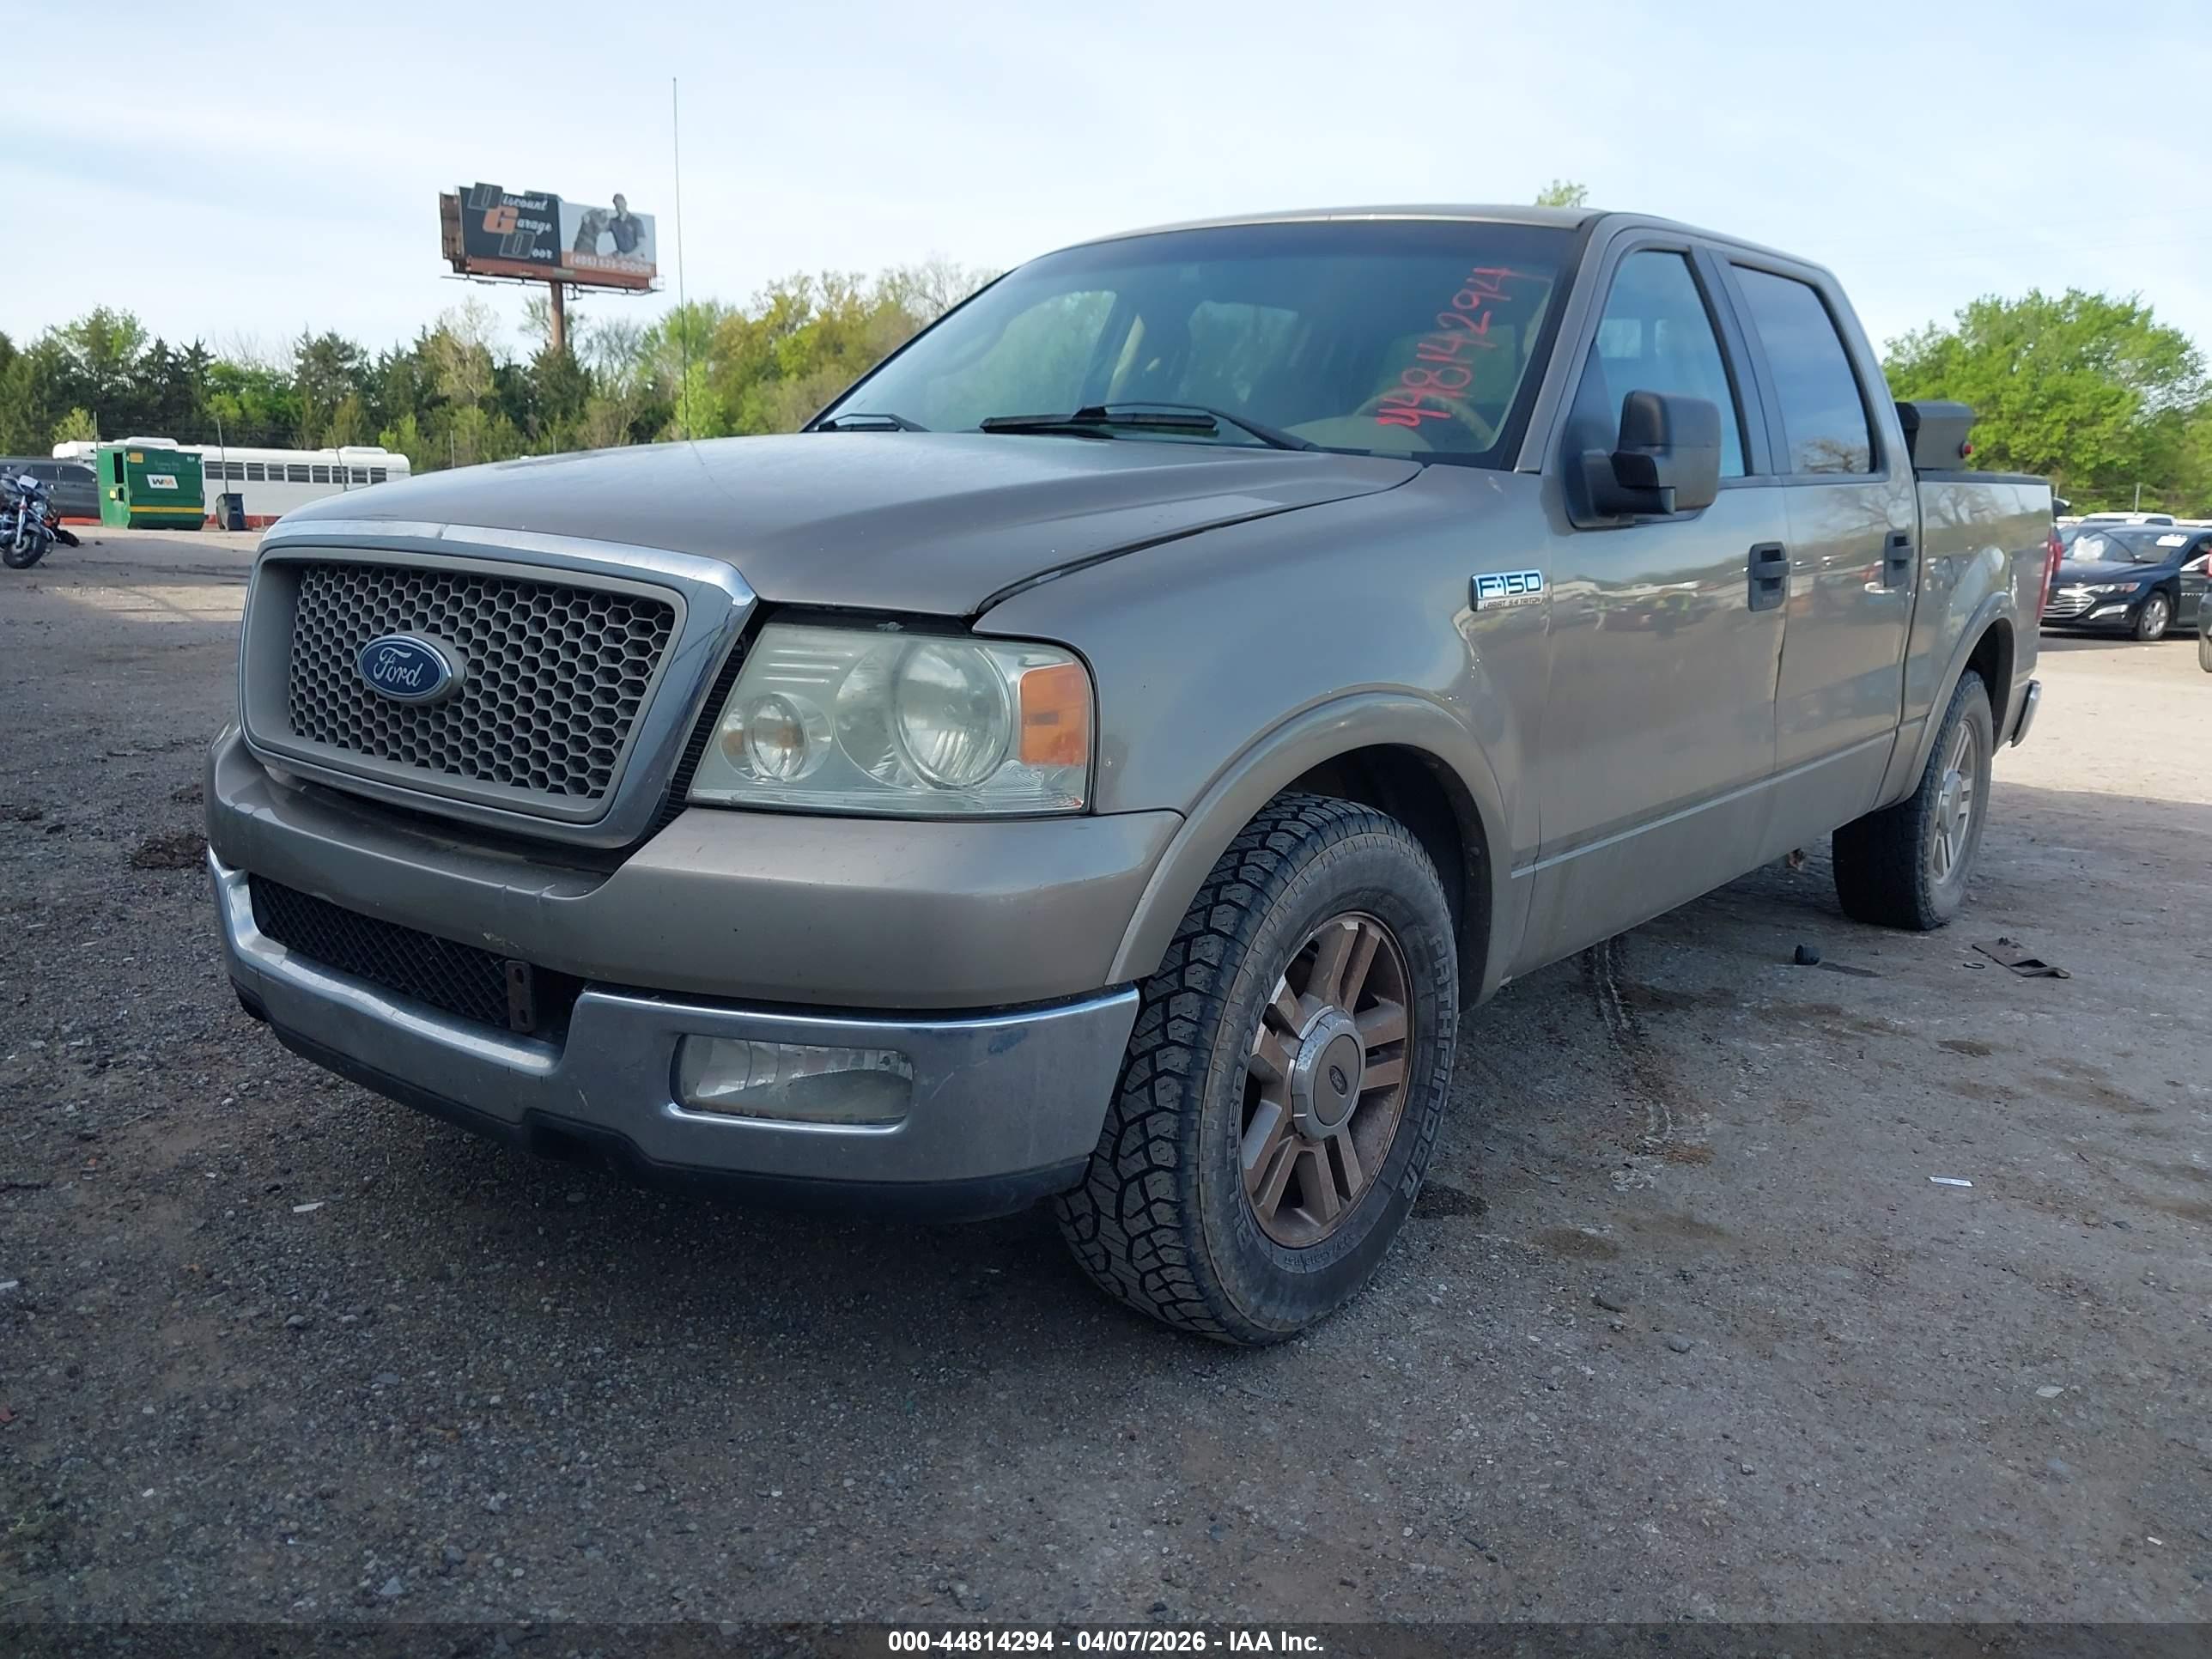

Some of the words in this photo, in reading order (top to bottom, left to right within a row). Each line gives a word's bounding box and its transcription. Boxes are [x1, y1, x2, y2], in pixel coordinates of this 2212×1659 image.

[483, 206, 553, 235] Garage
[1374, 267, 1547, 427] 44814294
[1478, 573, 1541, 598] F-150
[374, 647, 423, 688] Ford
[1402, 933, 1452, 1200] PATHFINDER
